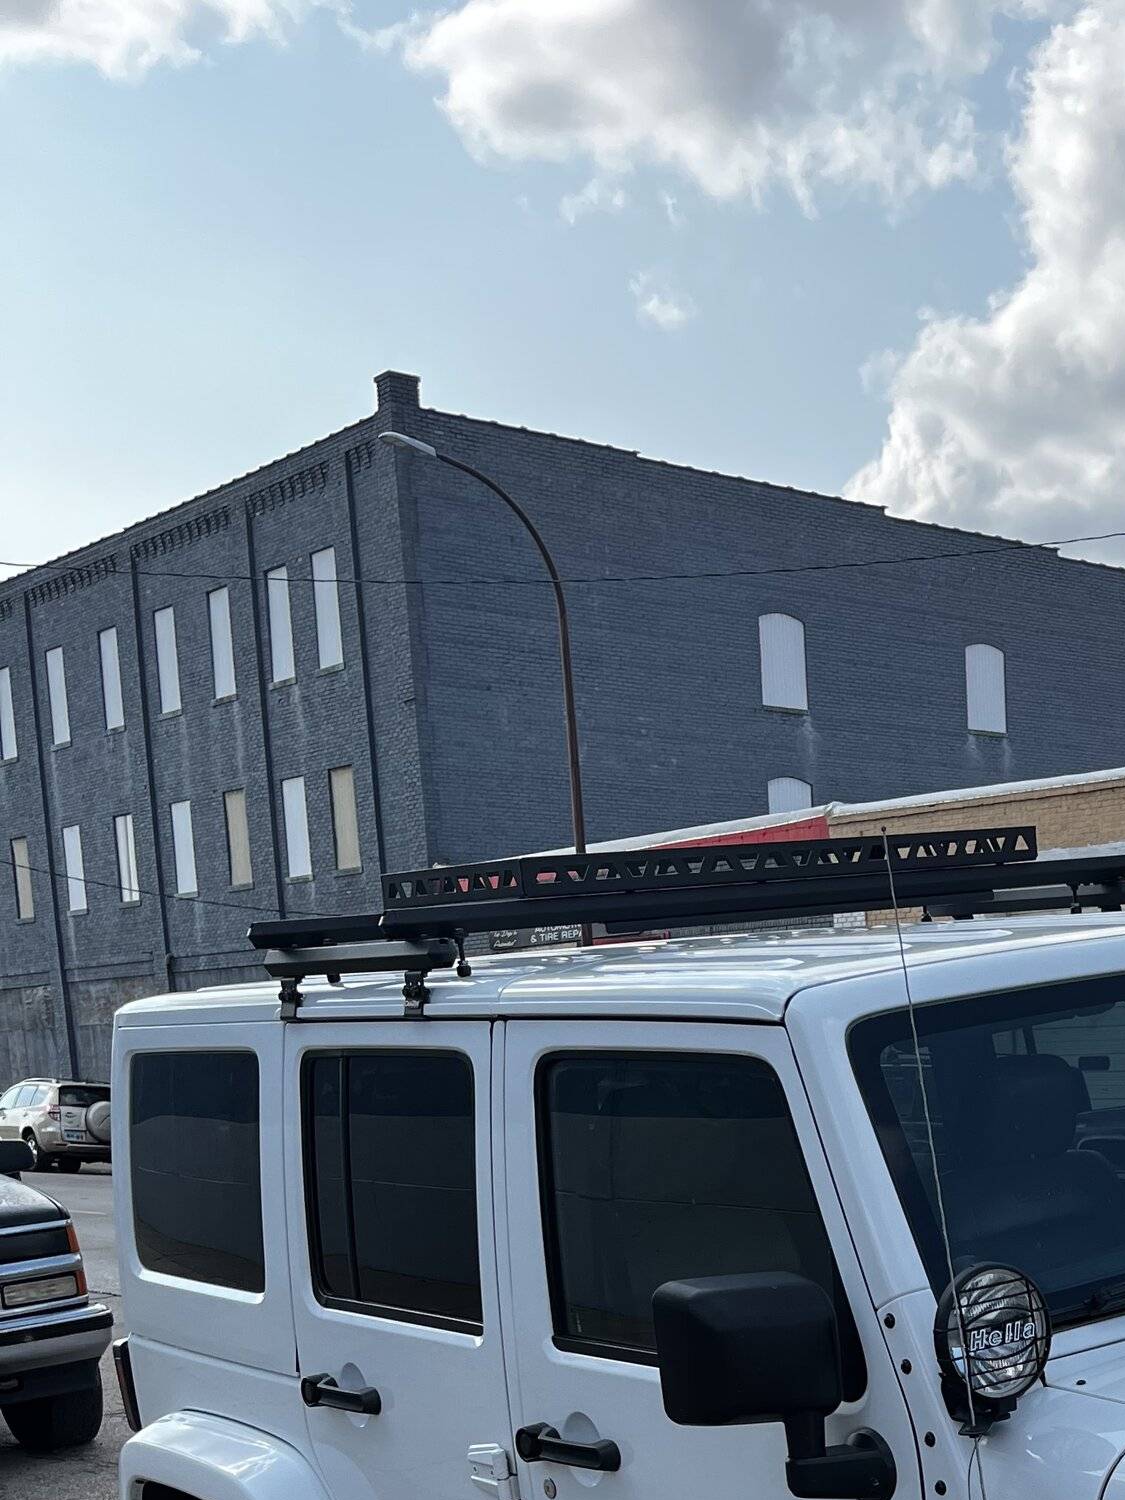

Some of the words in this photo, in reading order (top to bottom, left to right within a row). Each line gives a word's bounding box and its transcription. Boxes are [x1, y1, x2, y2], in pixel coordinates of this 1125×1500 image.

[530, 934, 537, 943] &
[539, 931, 559, 942] TIRE
[969, 1321, 1035, 1351] Hella
